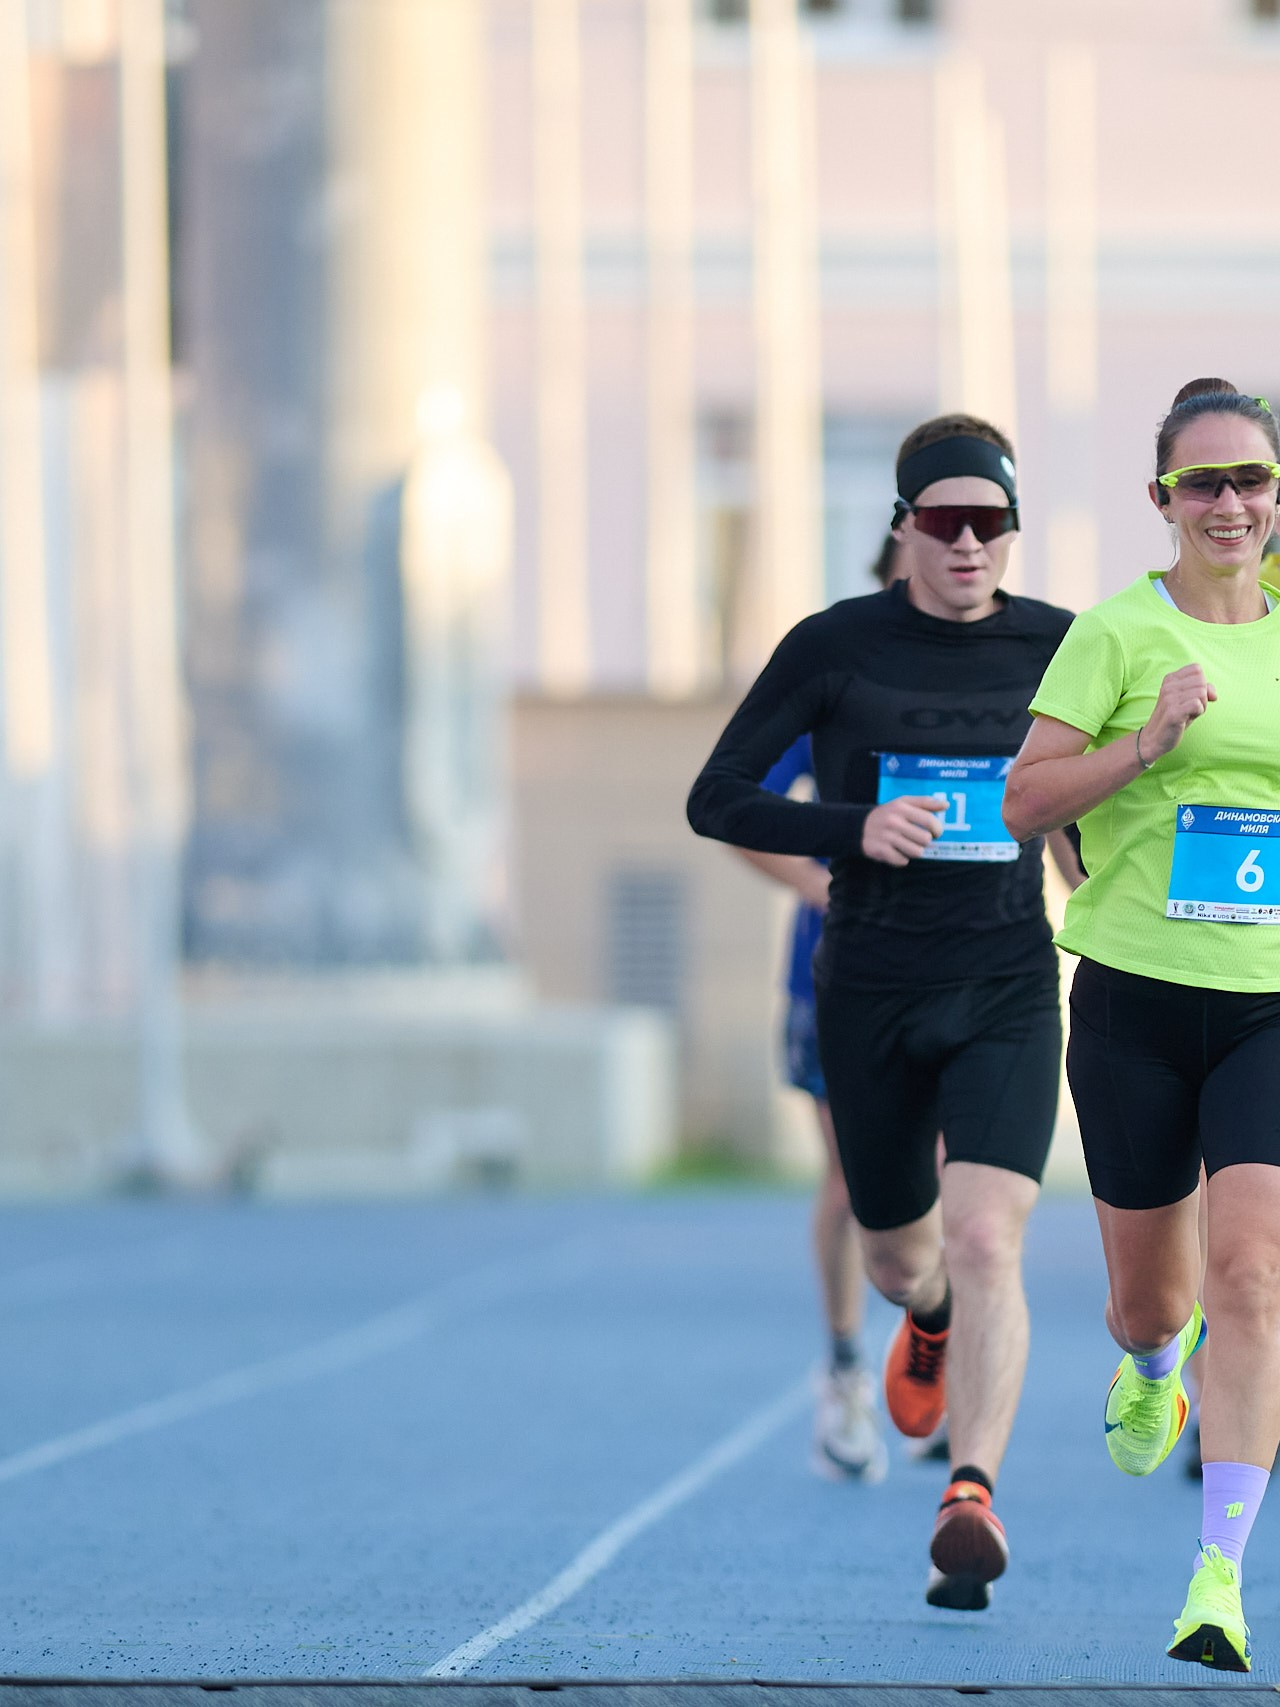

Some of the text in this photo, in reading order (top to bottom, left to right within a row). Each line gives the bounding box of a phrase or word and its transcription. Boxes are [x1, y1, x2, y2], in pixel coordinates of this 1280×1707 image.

[918, 759, 990, 769] ДИНАМОВСКАЯ
[933, 791, 971, 831] 11
[1239, 824, 1269, 834] МИЛЯ
[1235, 849, 1265, 893] 6
